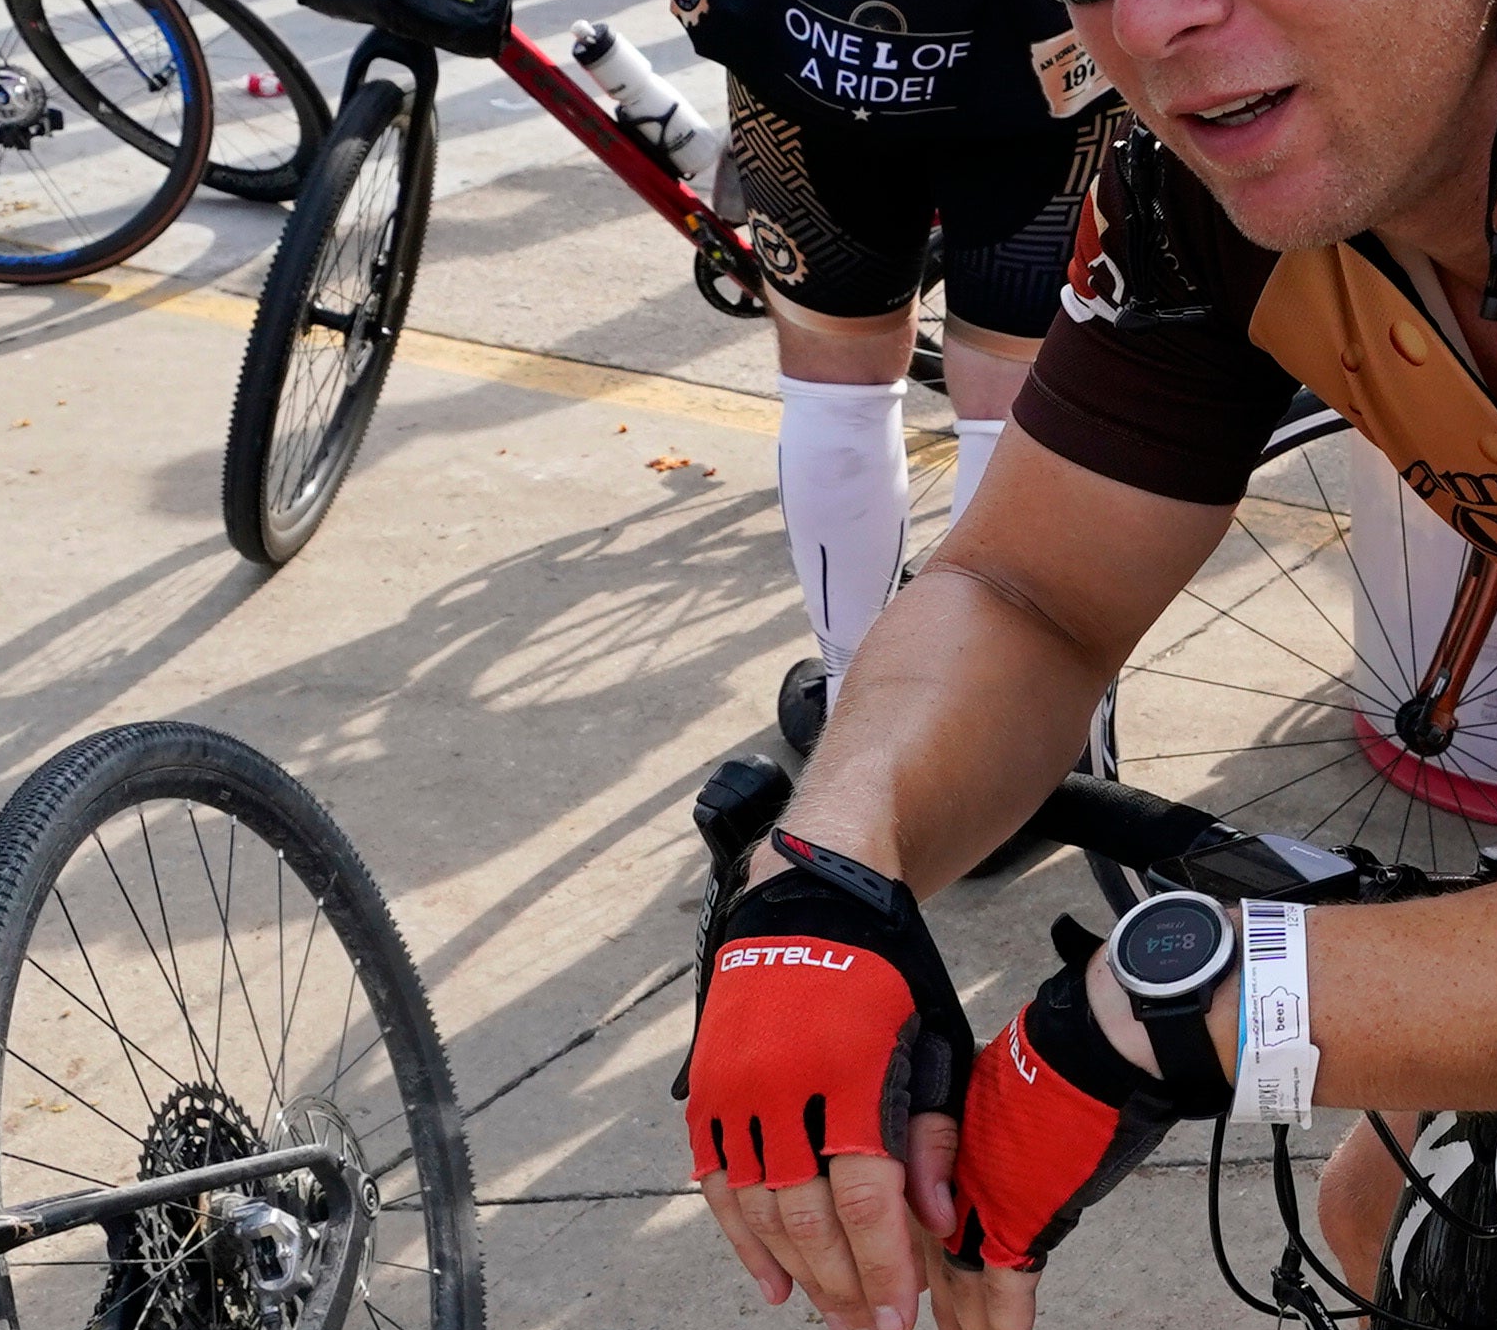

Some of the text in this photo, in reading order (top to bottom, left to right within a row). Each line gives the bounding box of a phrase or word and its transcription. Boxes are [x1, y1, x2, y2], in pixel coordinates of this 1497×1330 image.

[784, 7, 971, 70] ONE L OF
[799, 61, 935, 103] A RIDE!
[1061, 59, 1097, 93] 197
[1146, 933, 1197, 956] 8:54
[1273, 1001, 1286, 1033] beer
